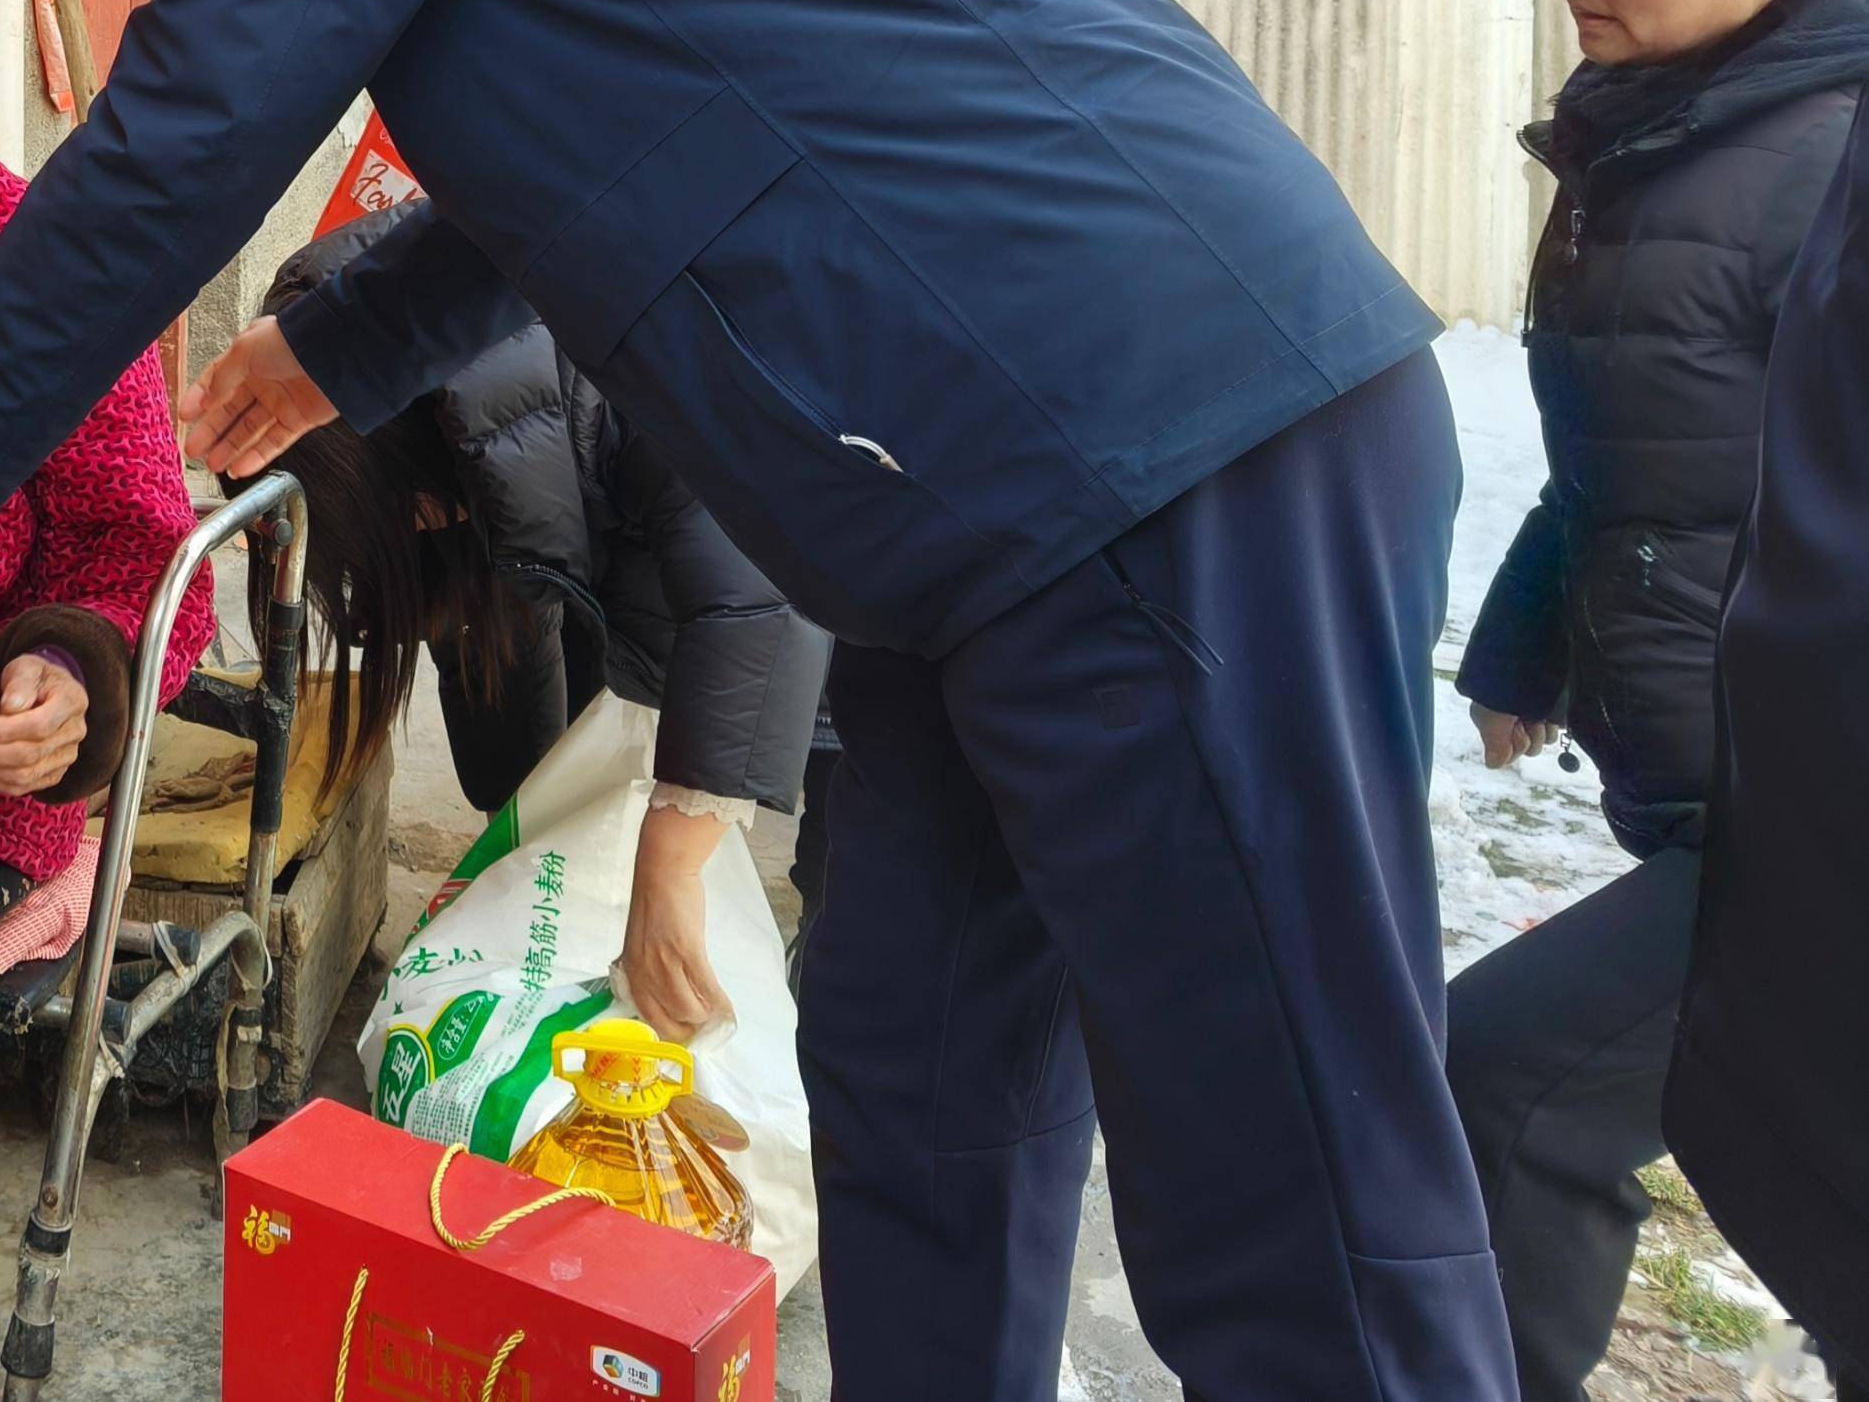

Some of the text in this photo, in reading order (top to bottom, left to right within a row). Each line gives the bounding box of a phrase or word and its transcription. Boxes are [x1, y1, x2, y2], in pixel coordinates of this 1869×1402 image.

[518, 849, 567, 994] 特高筋小麦粉
[382, 1041, 422, 1122] 五星
[627, 1376, 649, 1390] COFCO
